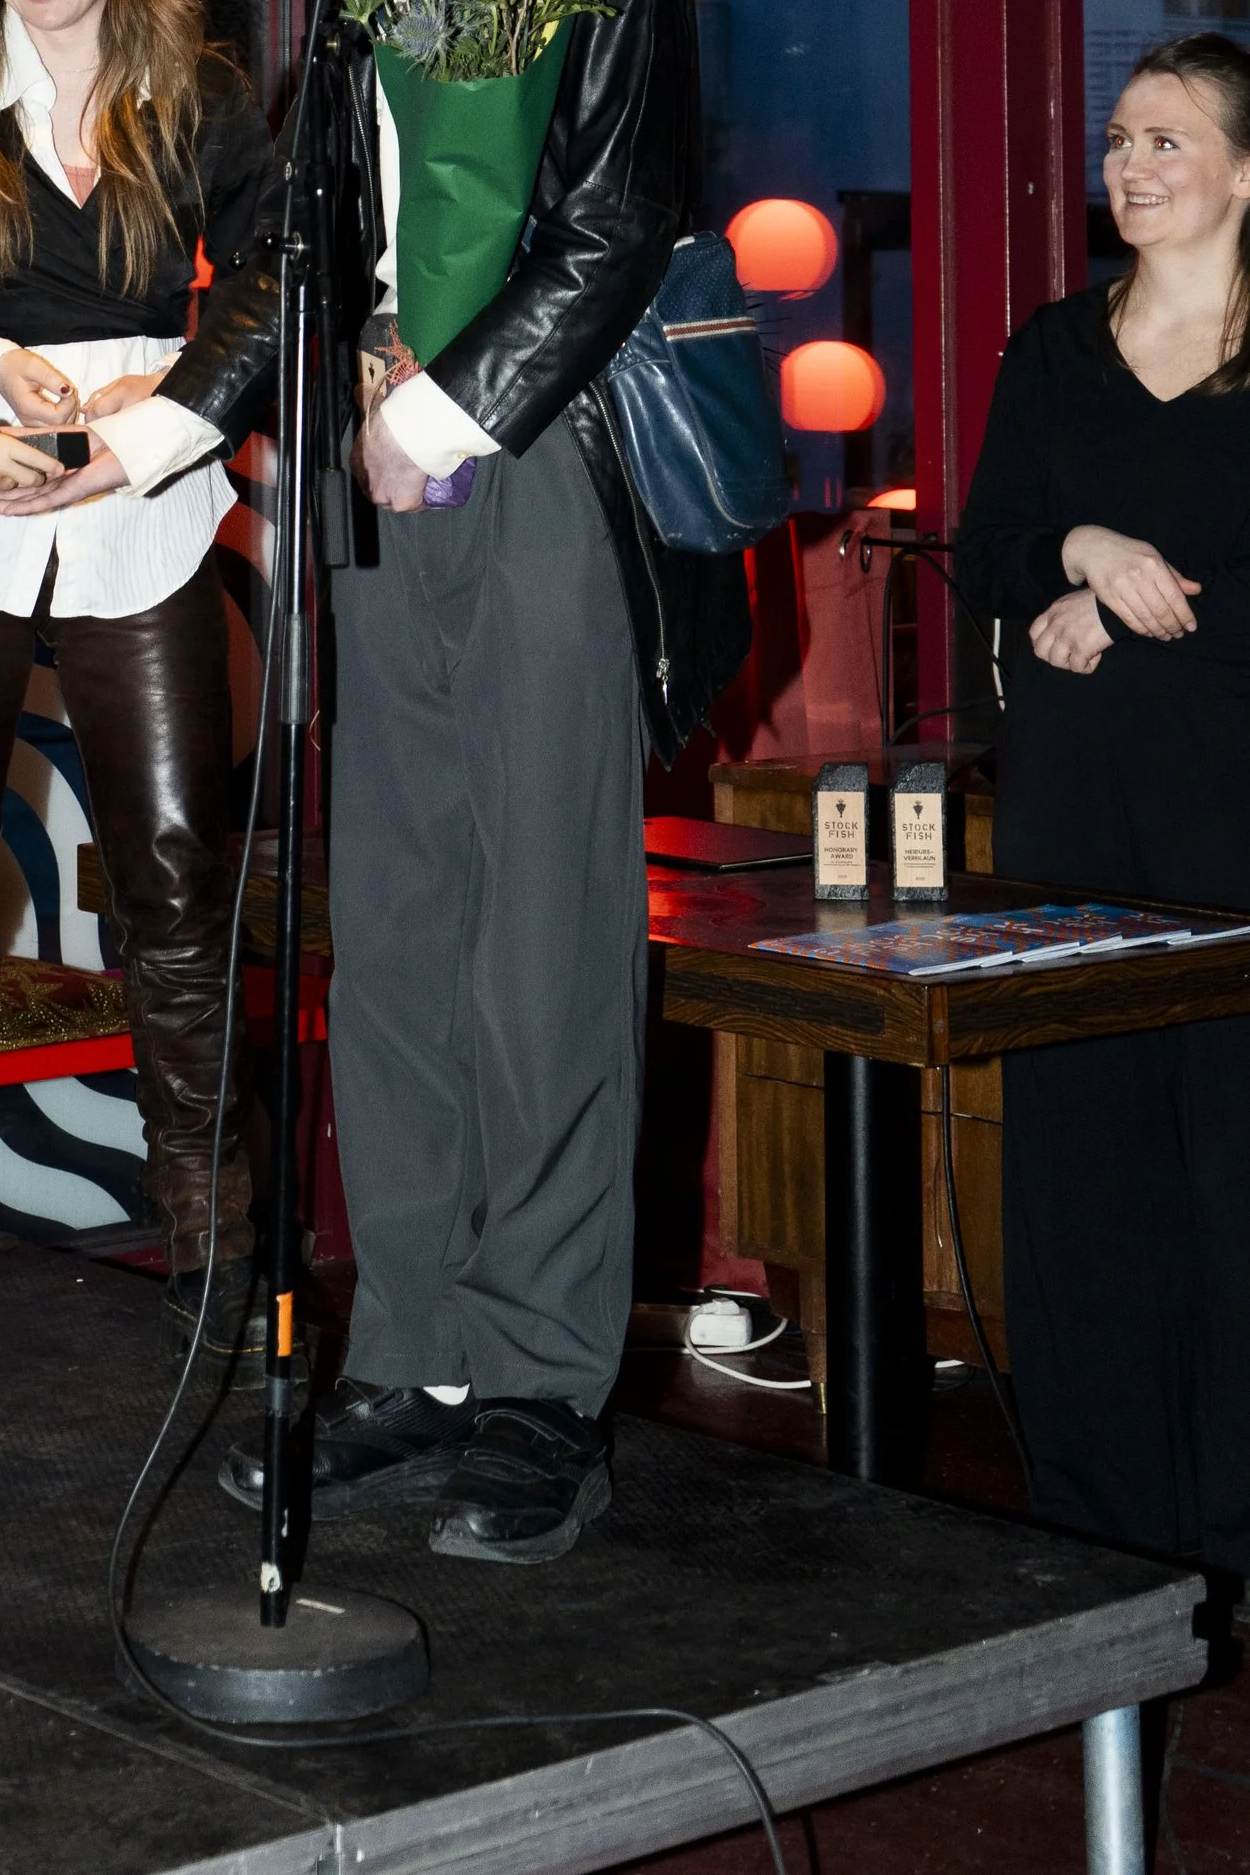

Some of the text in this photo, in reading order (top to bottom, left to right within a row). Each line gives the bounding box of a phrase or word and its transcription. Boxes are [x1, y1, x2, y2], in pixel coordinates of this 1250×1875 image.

[824, 821, 858, 830] STOCK
[902, 823, 936, 832] STOCK
[828, 830, 855, 838] FISH
[906, 832, 932, 840] FISH
